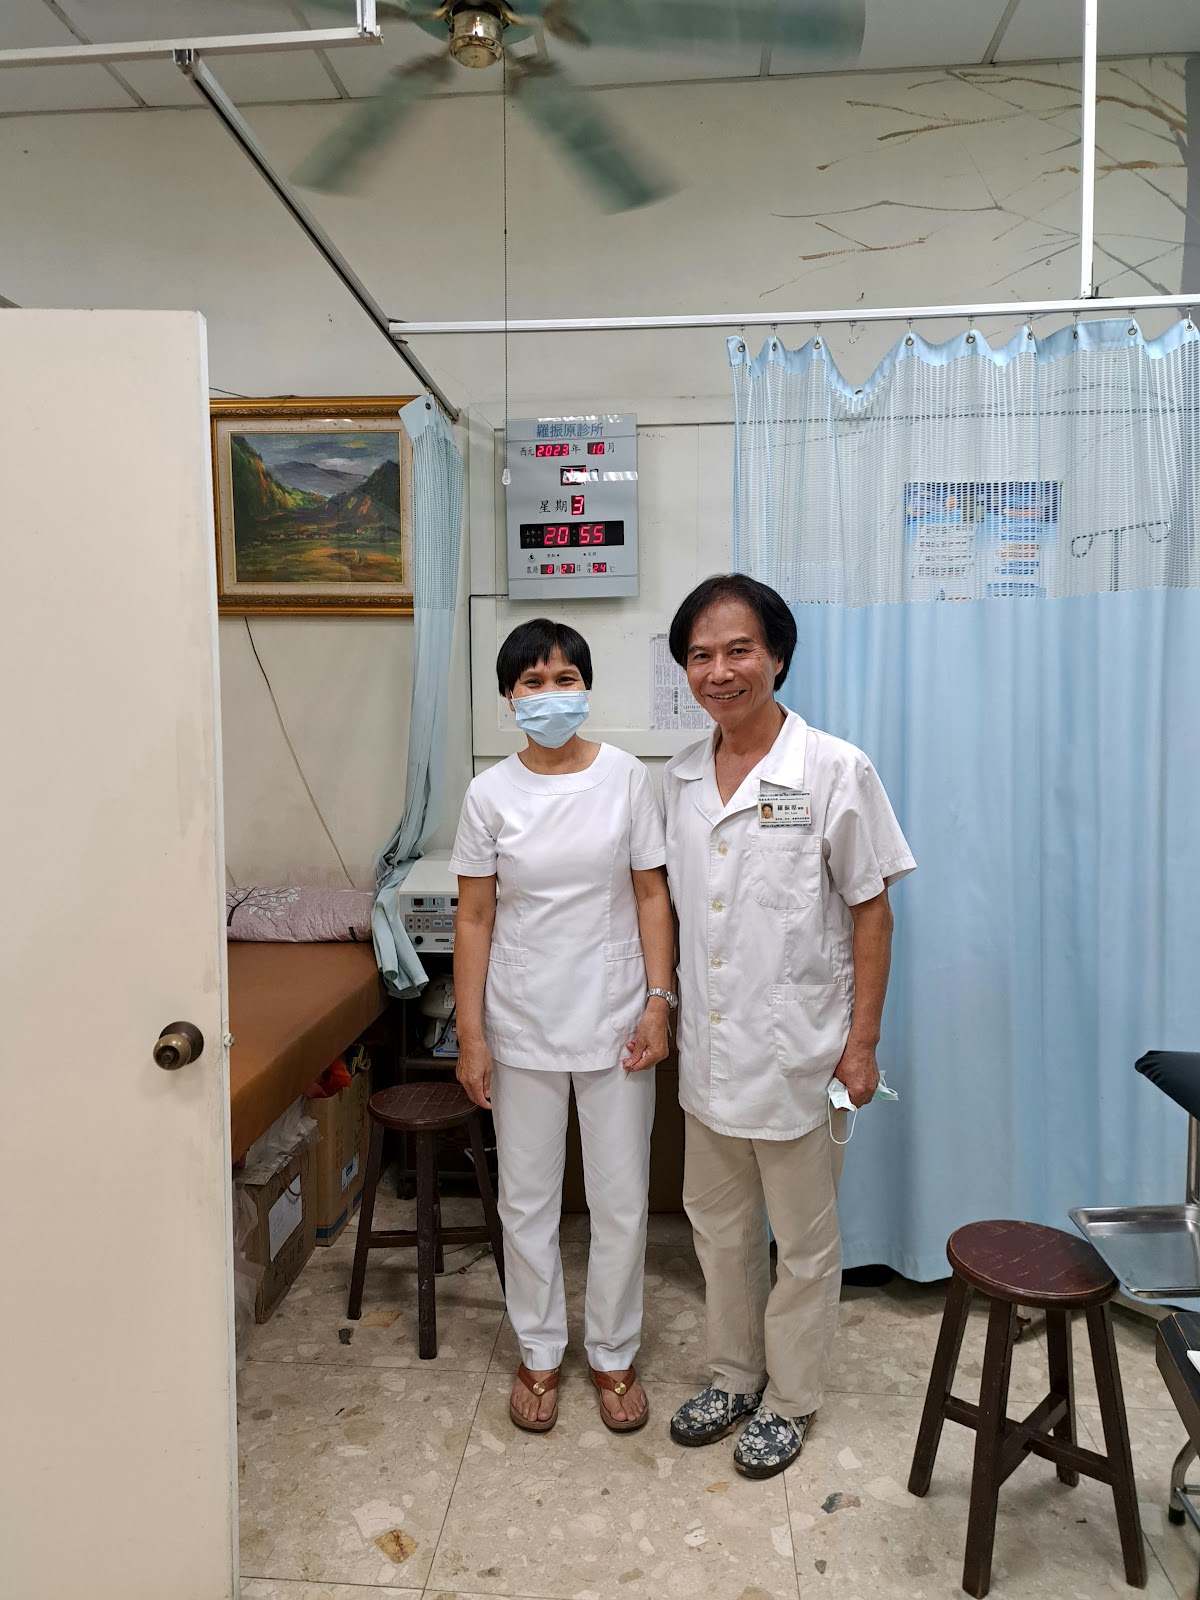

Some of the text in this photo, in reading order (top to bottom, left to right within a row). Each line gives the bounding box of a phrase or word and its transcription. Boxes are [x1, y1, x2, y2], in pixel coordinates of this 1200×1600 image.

[536, 422, 604, 438] 羅振原診所
[536, 444, 569, 457] 2023
[591, 443, 604, 455] 10
[572, 496, 584, 514] 3
